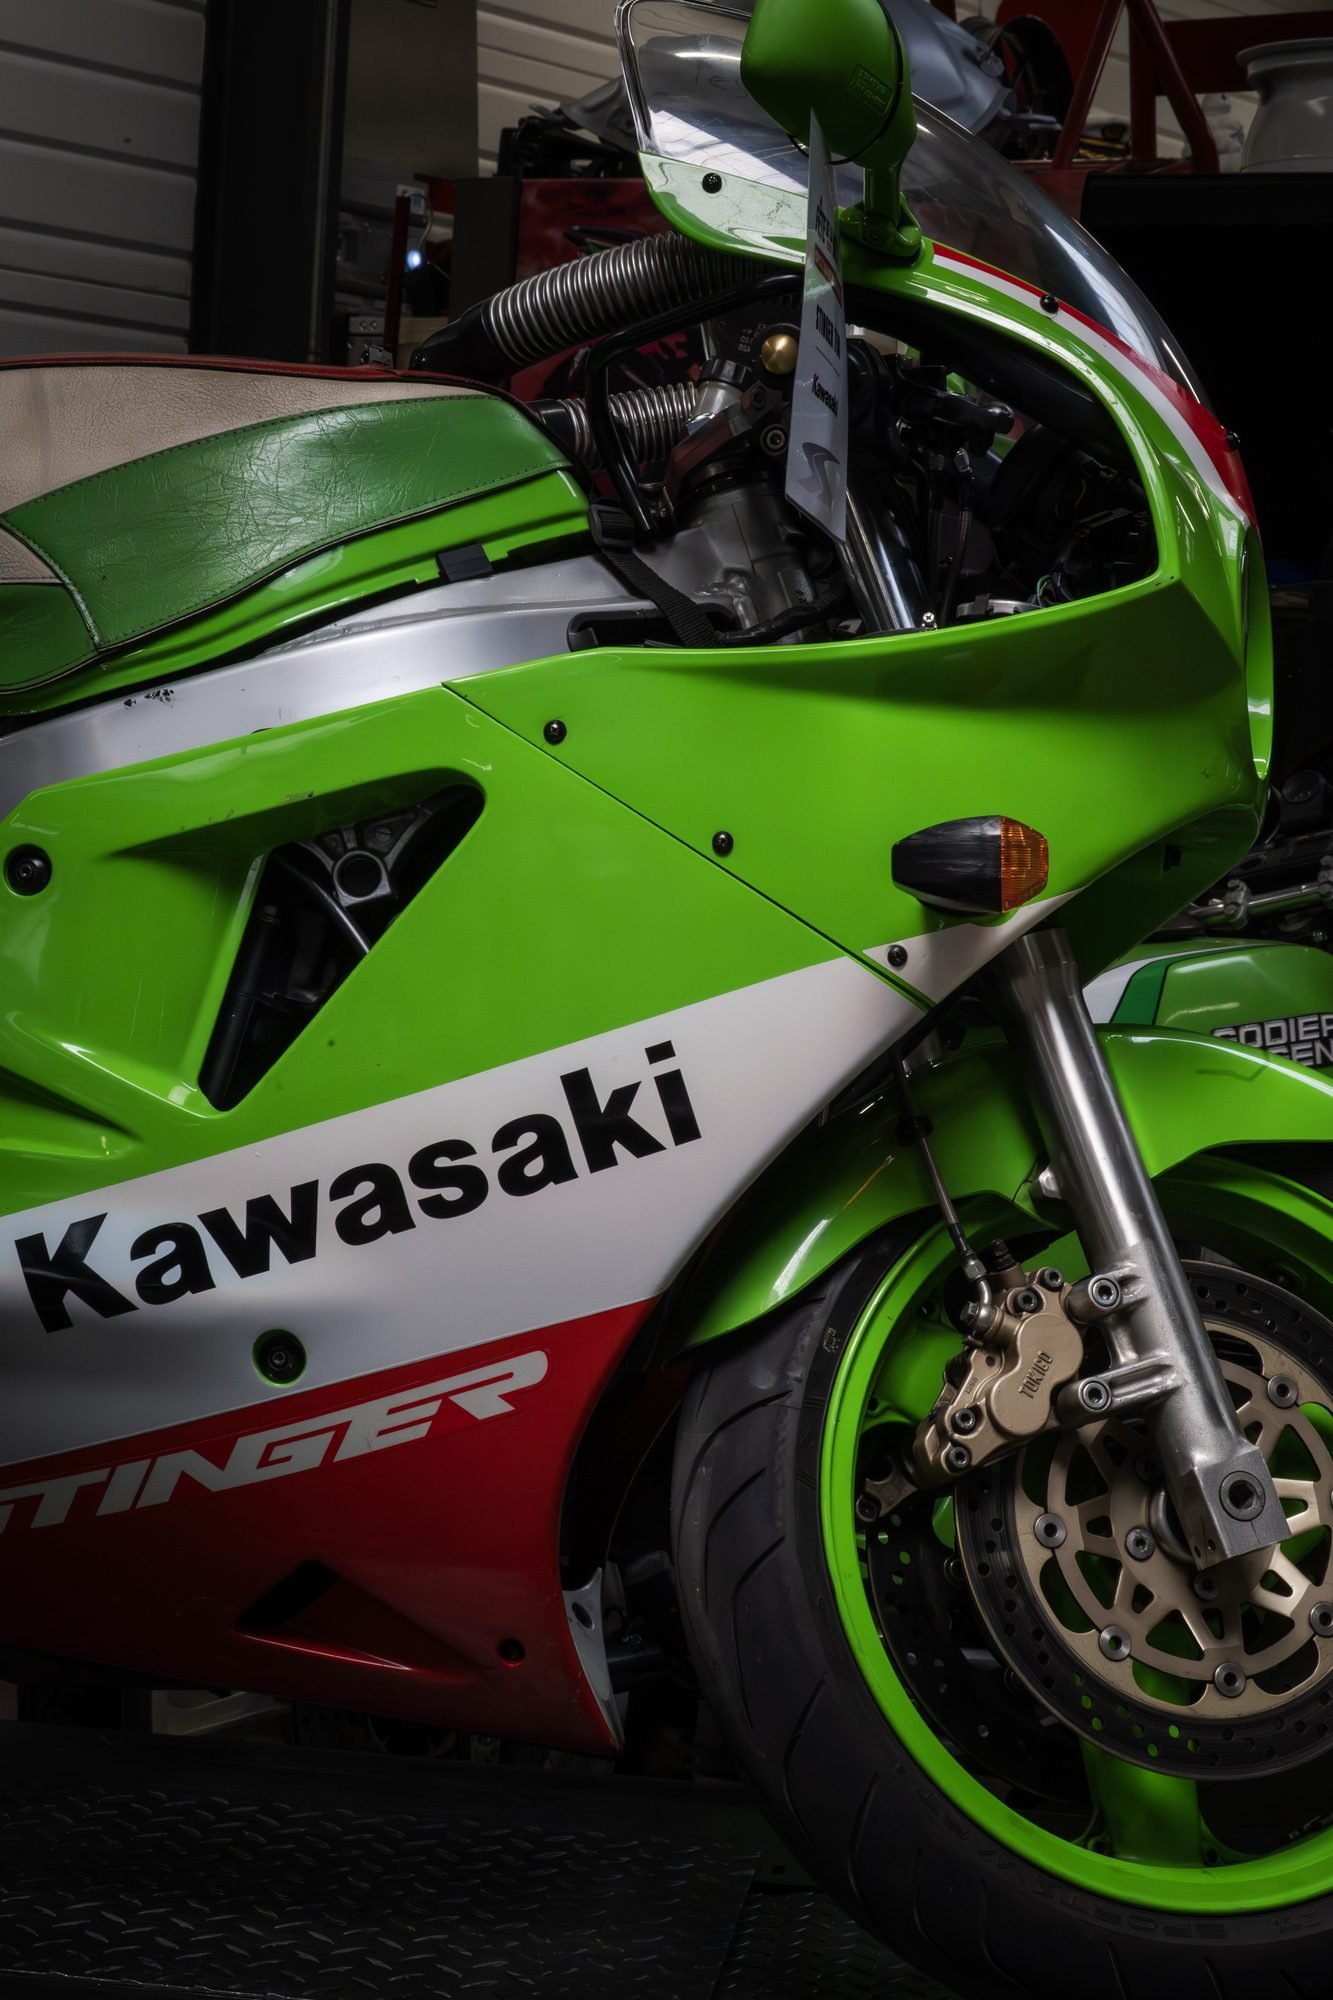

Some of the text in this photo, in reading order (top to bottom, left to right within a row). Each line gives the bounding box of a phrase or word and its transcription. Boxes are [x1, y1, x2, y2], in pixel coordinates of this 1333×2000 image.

[812, 373, 838, 417] Kawasaki
[15, 1040, 702, 1333] Kawasaki
[1018, 1350, 1053, 1398] TOKICO
[0, 1350, 548, 1534] TINGER
